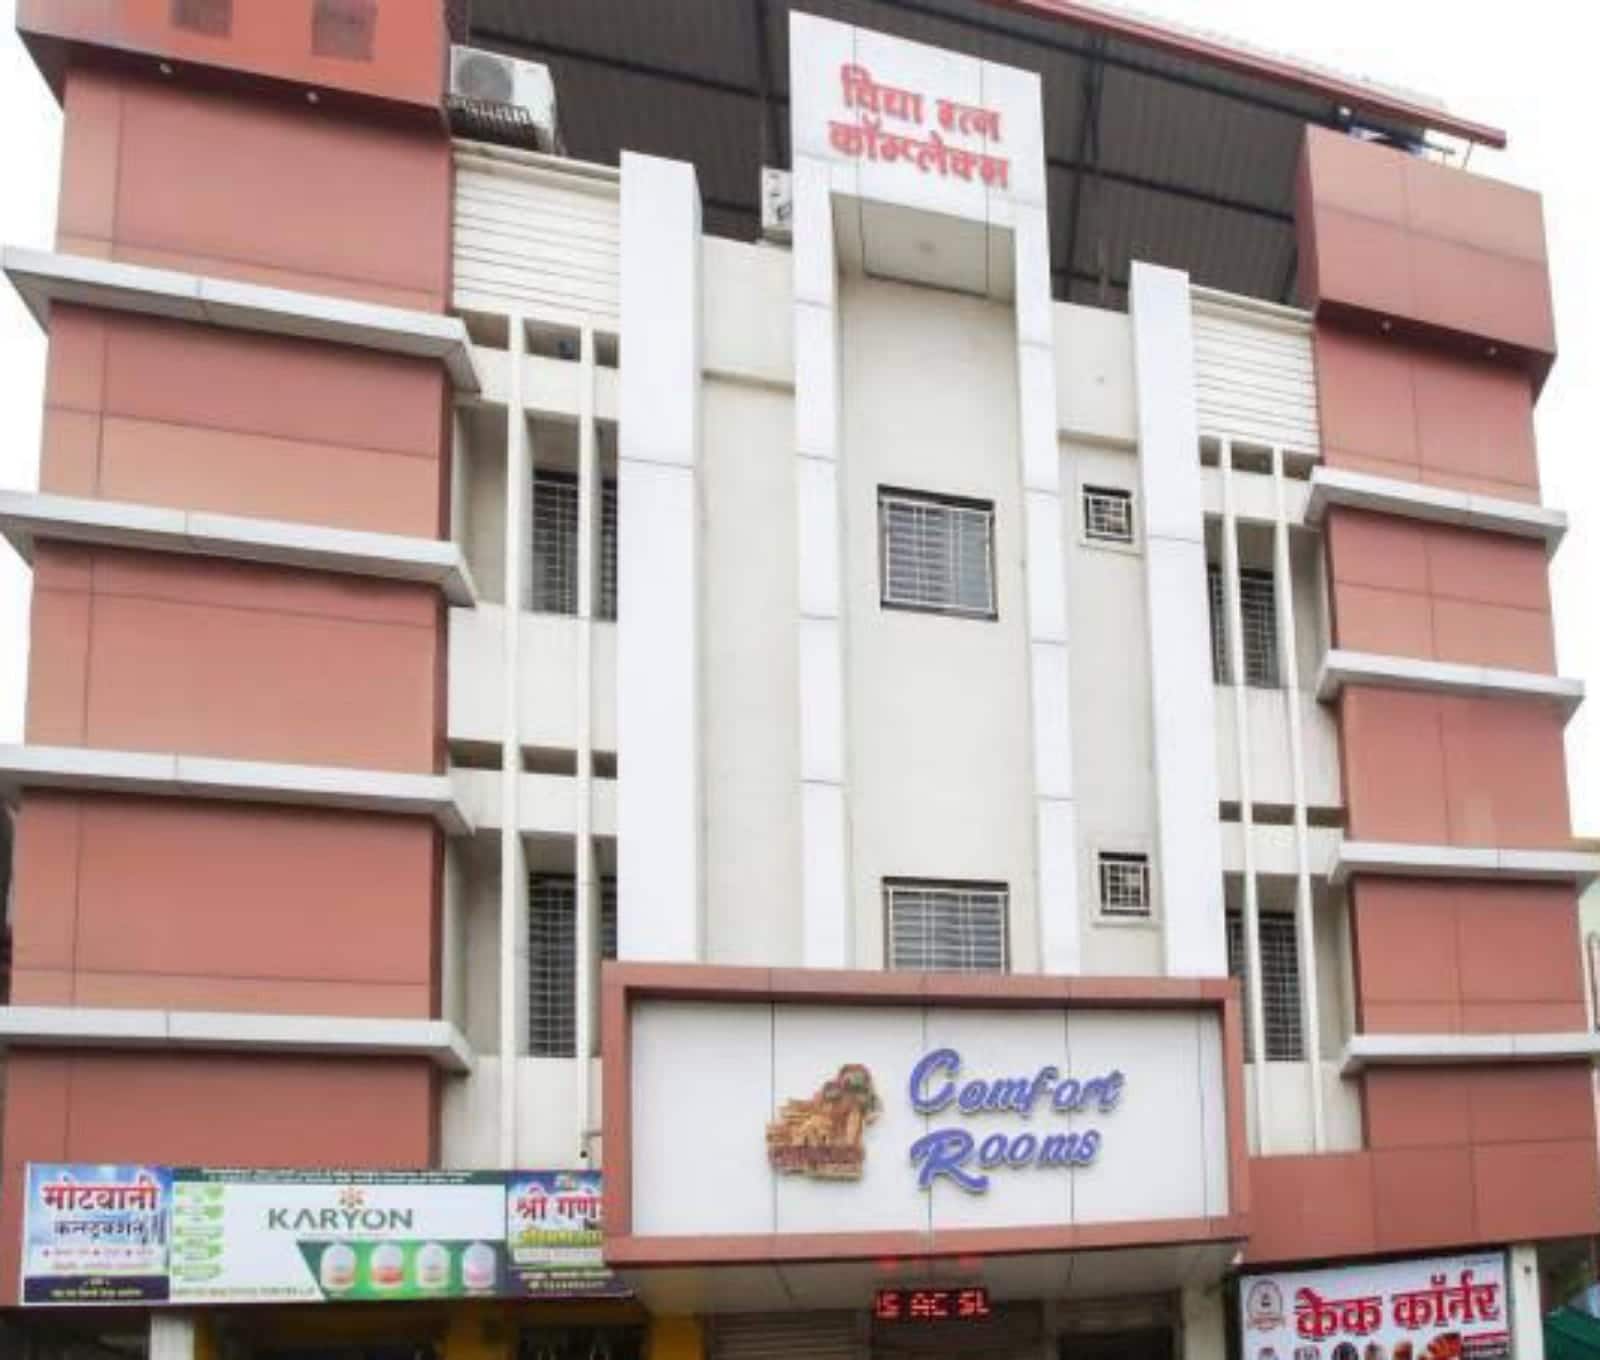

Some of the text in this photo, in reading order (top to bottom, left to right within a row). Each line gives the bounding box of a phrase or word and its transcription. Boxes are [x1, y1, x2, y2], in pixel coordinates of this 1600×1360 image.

[840, 63, 924, 124] विद्या
[909, 1048, 1123, 1117] Comfort
[909, 1129, 1101, 1193] Rooms
[42, 1174, 157, 1210] मोटवानी
[268, 1208, 412, 1230] KARYON
[516, 1186, 547, 1220] श्री
[1294, 1269, 1499, 1341] केक कॉर्नर
